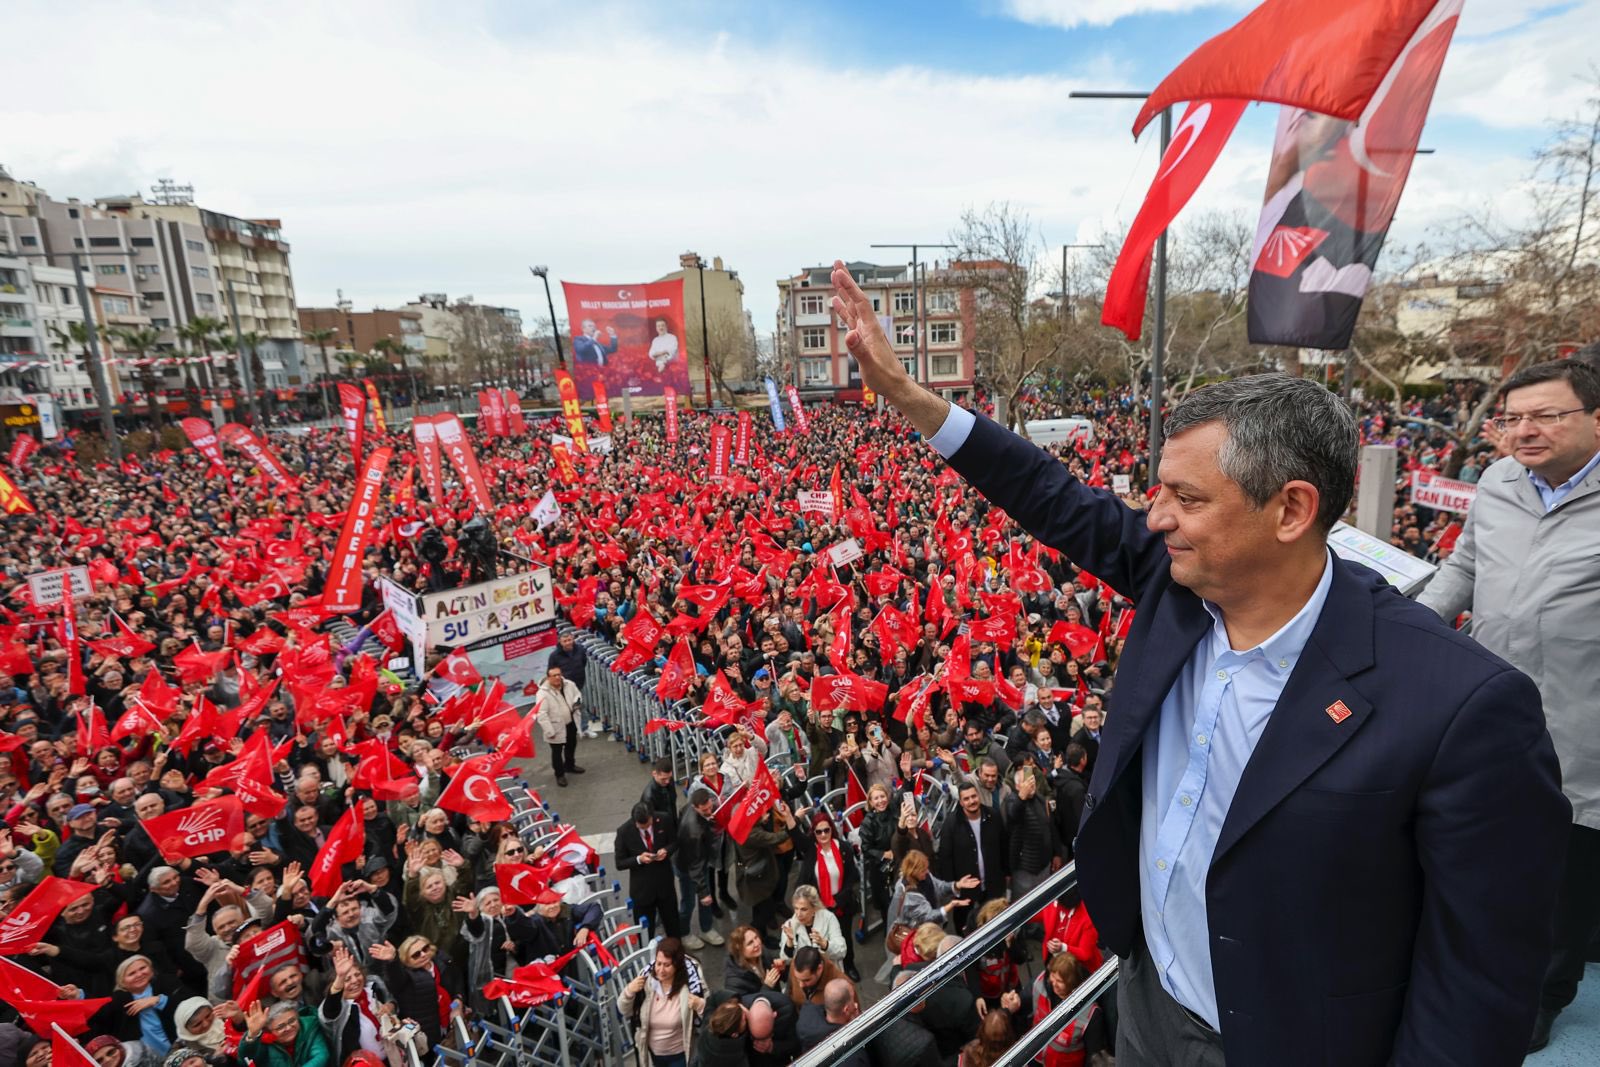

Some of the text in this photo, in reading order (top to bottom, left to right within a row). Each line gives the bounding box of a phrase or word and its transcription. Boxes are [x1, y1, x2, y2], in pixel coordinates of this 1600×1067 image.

[810, 492, 828, 500] CHP
[334, 485, 375, 604] EDREMİT
[436, 592, 487, 619] ALTIN
[444, 598, 545, 642] SU YAŞATIR
[184, 828, 227, 847] CHP
